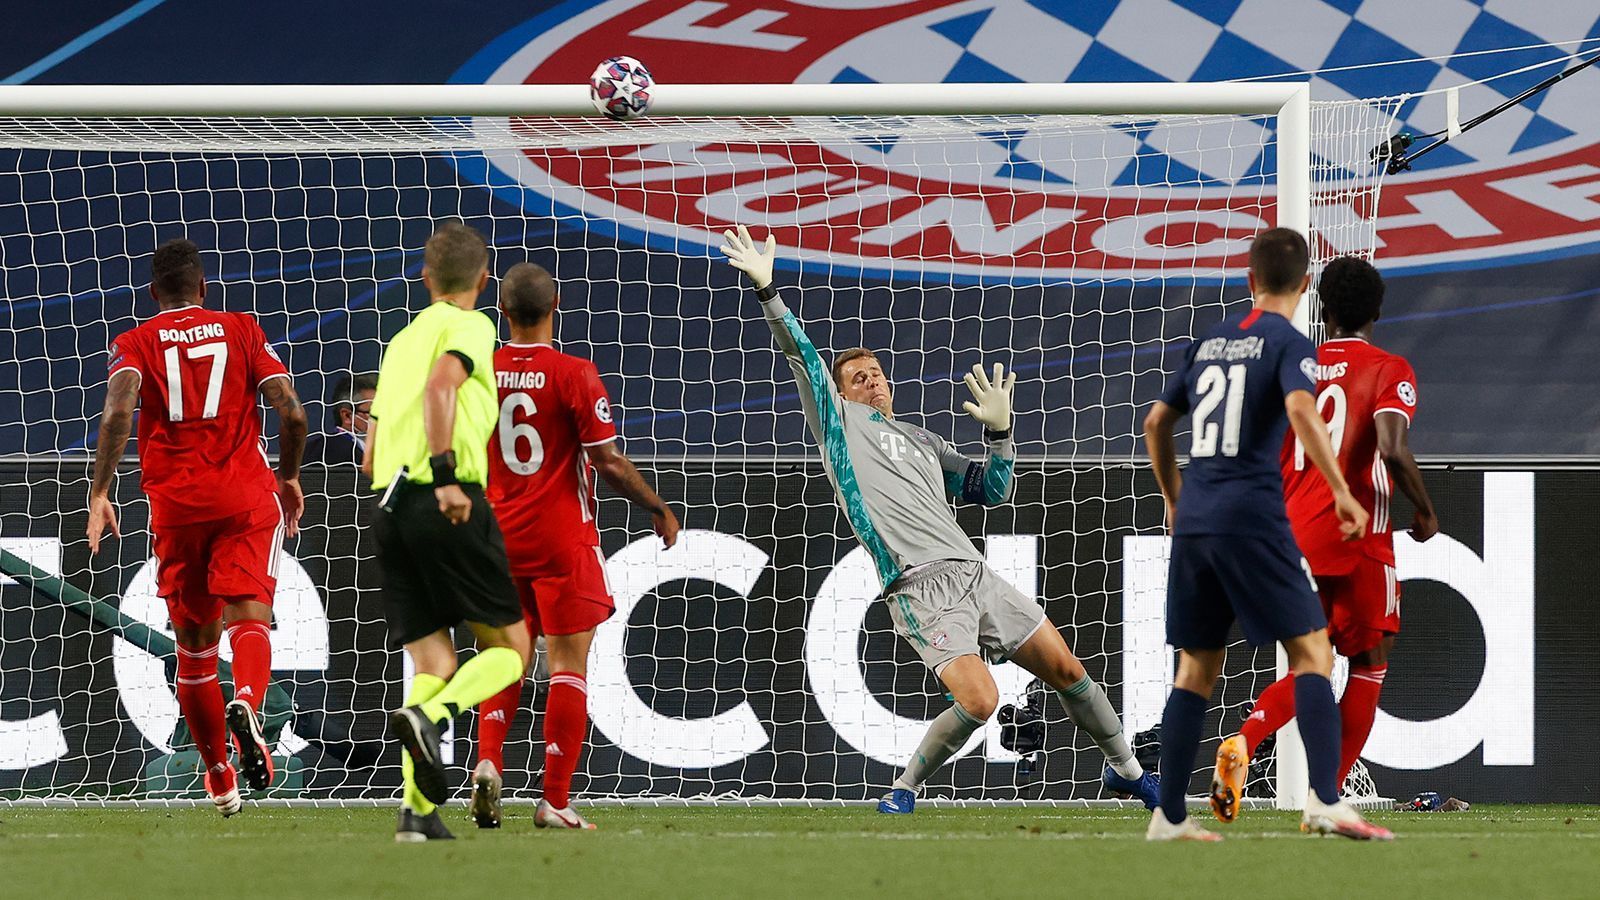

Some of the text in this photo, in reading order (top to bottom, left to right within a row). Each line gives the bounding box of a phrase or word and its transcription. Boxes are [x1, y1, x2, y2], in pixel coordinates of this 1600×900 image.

[158, 323, 225, 344] BOATENG
[164, 341, 228, 422] 17
[496, 371, 546, 389] THIAGO
[1314, 361, 1348, 381] AVIES
[498, 392, 544, 476] 6
[1190, 363, 1247, 457] 21
